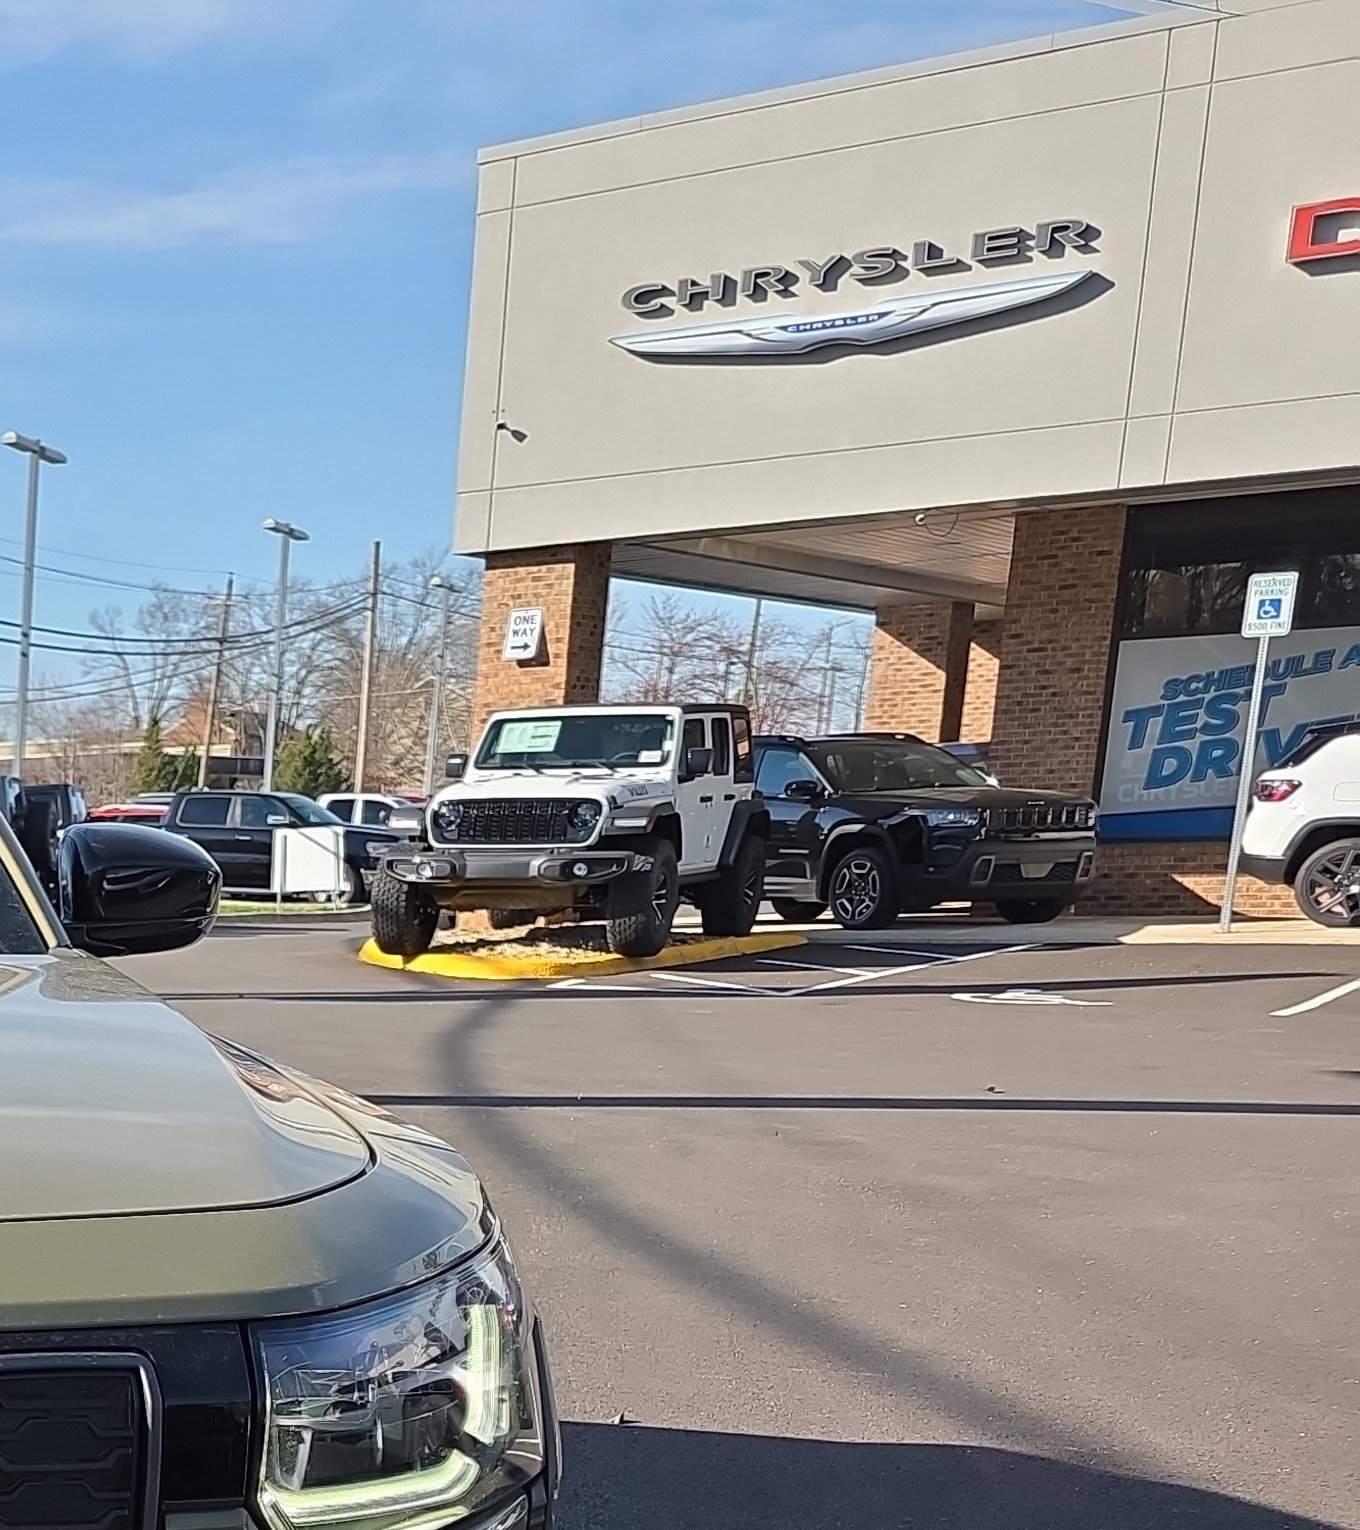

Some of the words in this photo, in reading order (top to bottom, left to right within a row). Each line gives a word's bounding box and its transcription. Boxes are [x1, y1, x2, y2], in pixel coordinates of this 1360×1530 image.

[620, 217, 1096, 315] CHRYSLER
[787, 312, 880, 332] CHRYSLER
[1253, 578, 1293, 588] RESERVED
[1254, 588, 1290, 597] PARKING
[514, 614, 537, 626] ONE
[512, 626, 536, 638] WAY
[1122, 681, 1287, 750] TEST
[1143, 714, 1355, 790] DRV
